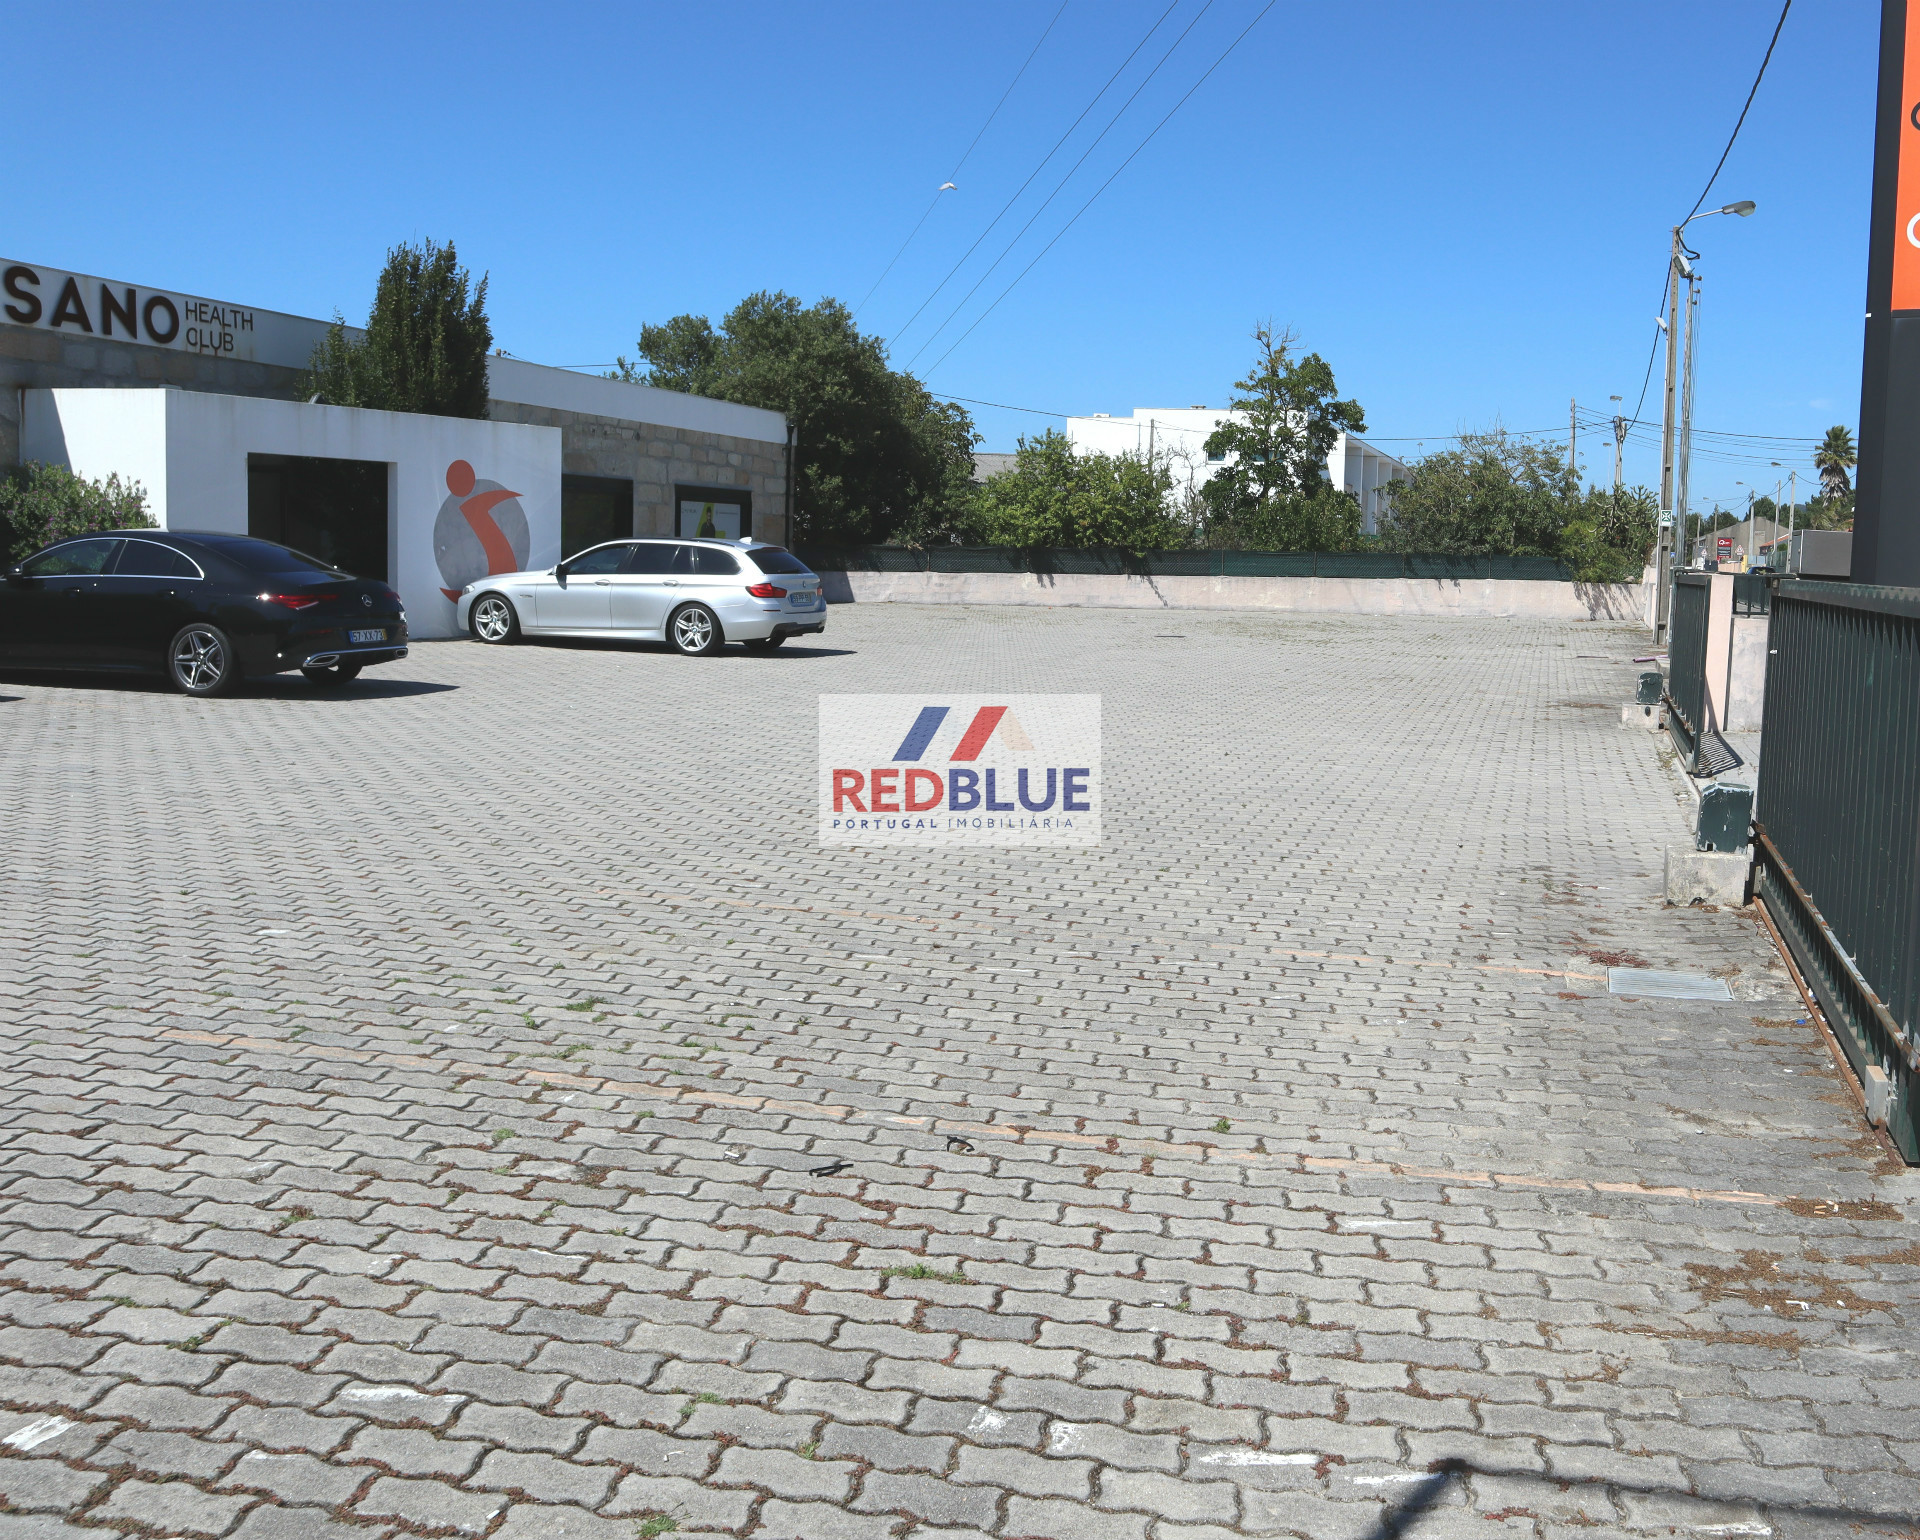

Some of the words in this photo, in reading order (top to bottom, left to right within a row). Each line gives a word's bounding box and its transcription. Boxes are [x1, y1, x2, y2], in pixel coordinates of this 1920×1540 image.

[4, 266, 180, 344] SANO
[185, 300, 254, 332] HEALTH
[186, 327, 235, 352] CLUB
